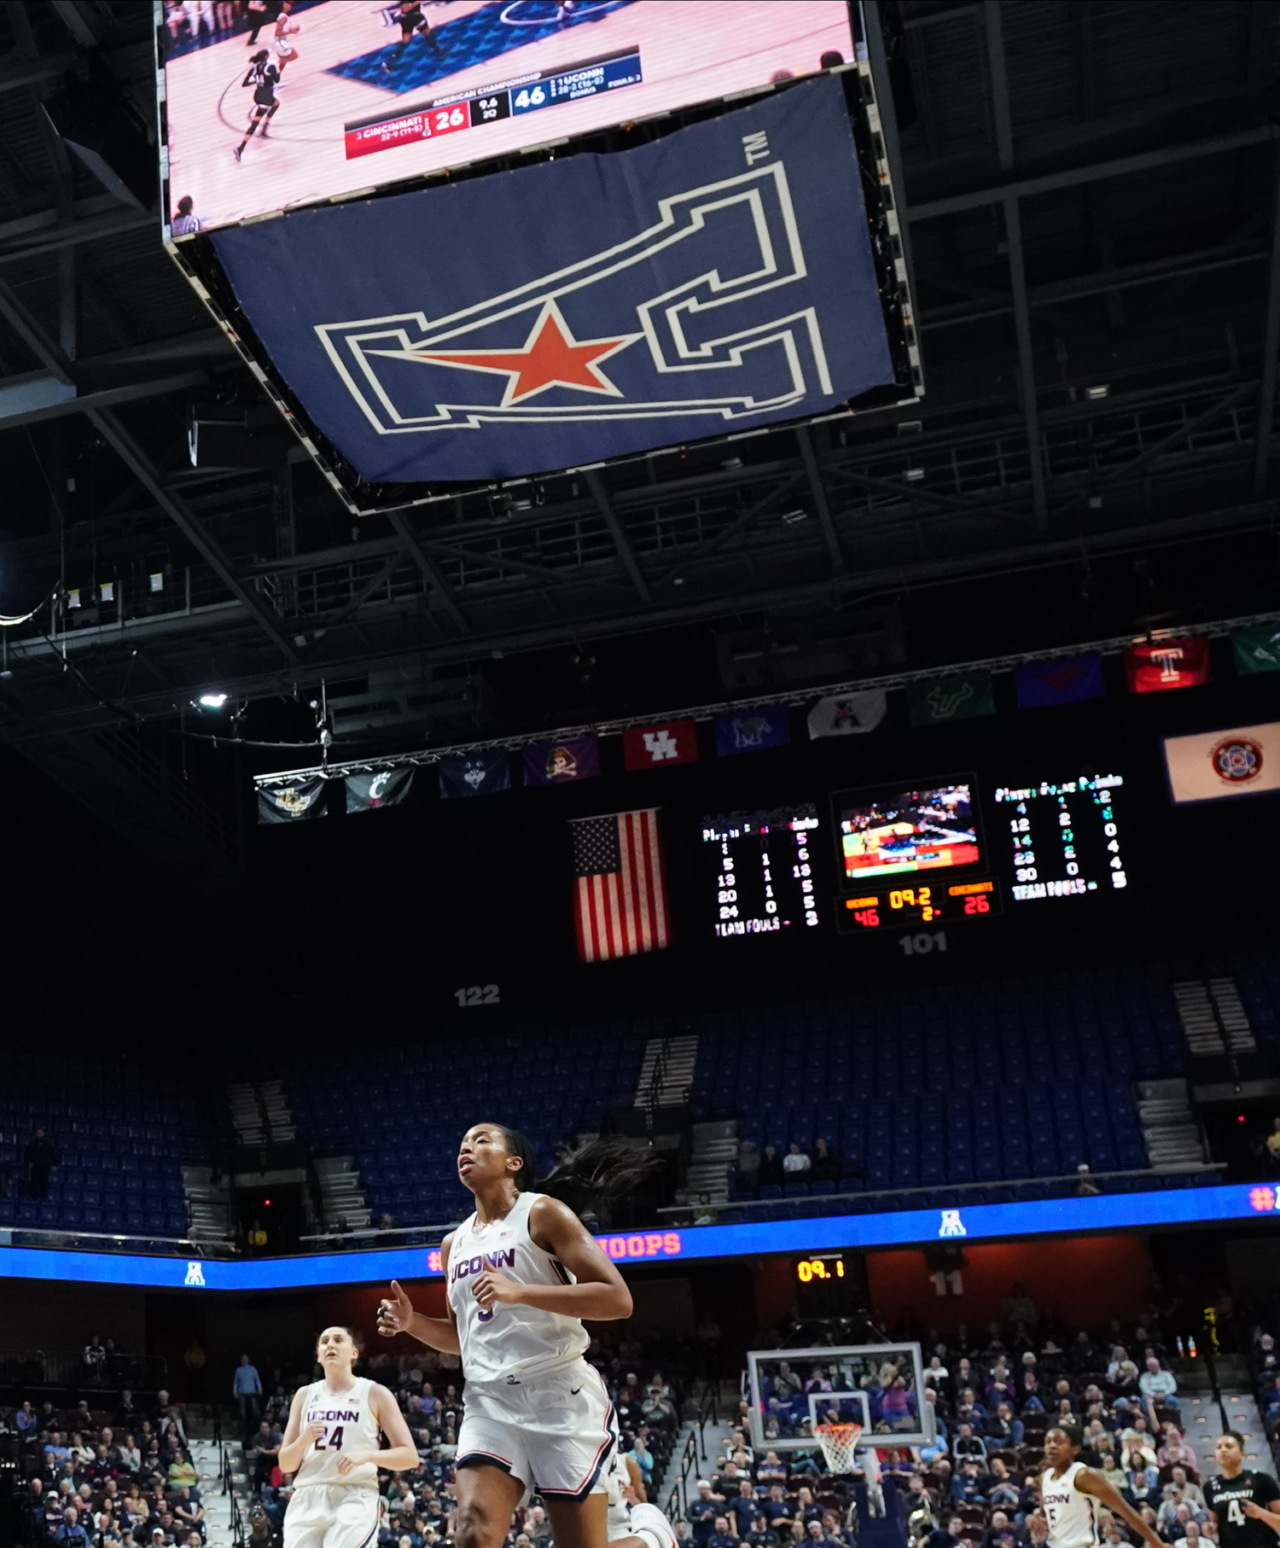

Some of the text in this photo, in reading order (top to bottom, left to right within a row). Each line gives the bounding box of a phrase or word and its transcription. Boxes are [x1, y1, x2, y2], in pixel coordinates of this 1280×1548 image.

[564, 67, 605, 85] UCONN
[433, 88, 477, 107] AMERICAN
[477, 72, 542, 95] CHAMPIONSHIP
[515, 86, 546, 108] 46
[479, 97, 498, 110] 9.6
[436, 108, 464, 130] 26
[363, 116, 423, 139] CINCINNATI
[1104, 823, 1117, 837] 0
[1107, 839, 1119, 853] 4
[762, 853, 771, 866] 1
[798, 848, 810, 860] 6
[723, 858, 734, 871] 5
[1066, 862, 1079, 876] 0
[1110, 856, 1122, 870] 4
[763, 868, 772, 882] 1
[765, 884, 774, 898] 1
[802, 879, 813, 893] 5
[718, 889, 738, 904] 20
[803, 895, 815, 909] 5
[889, 887, 931, 909] 09.2
[765, 900, 777, 914] 0
[964, 895, 990, 914] 26
[720, 905, 739, 920] 24
[854, 908, 880, 926] 46
[898, 931, 947, 956] 101
[453, 983, 501, 1007] 122
[451, 1247, 515, 1285] UCONN
[797, 1260, 845, 1283] 09.1
[930, 1270, 964, 1296] 11
[307, 1410, 360, 1423] UCONN
[314, 1425, 344, 1451] 24
[1228, 1499, 1246, 1526] 4
